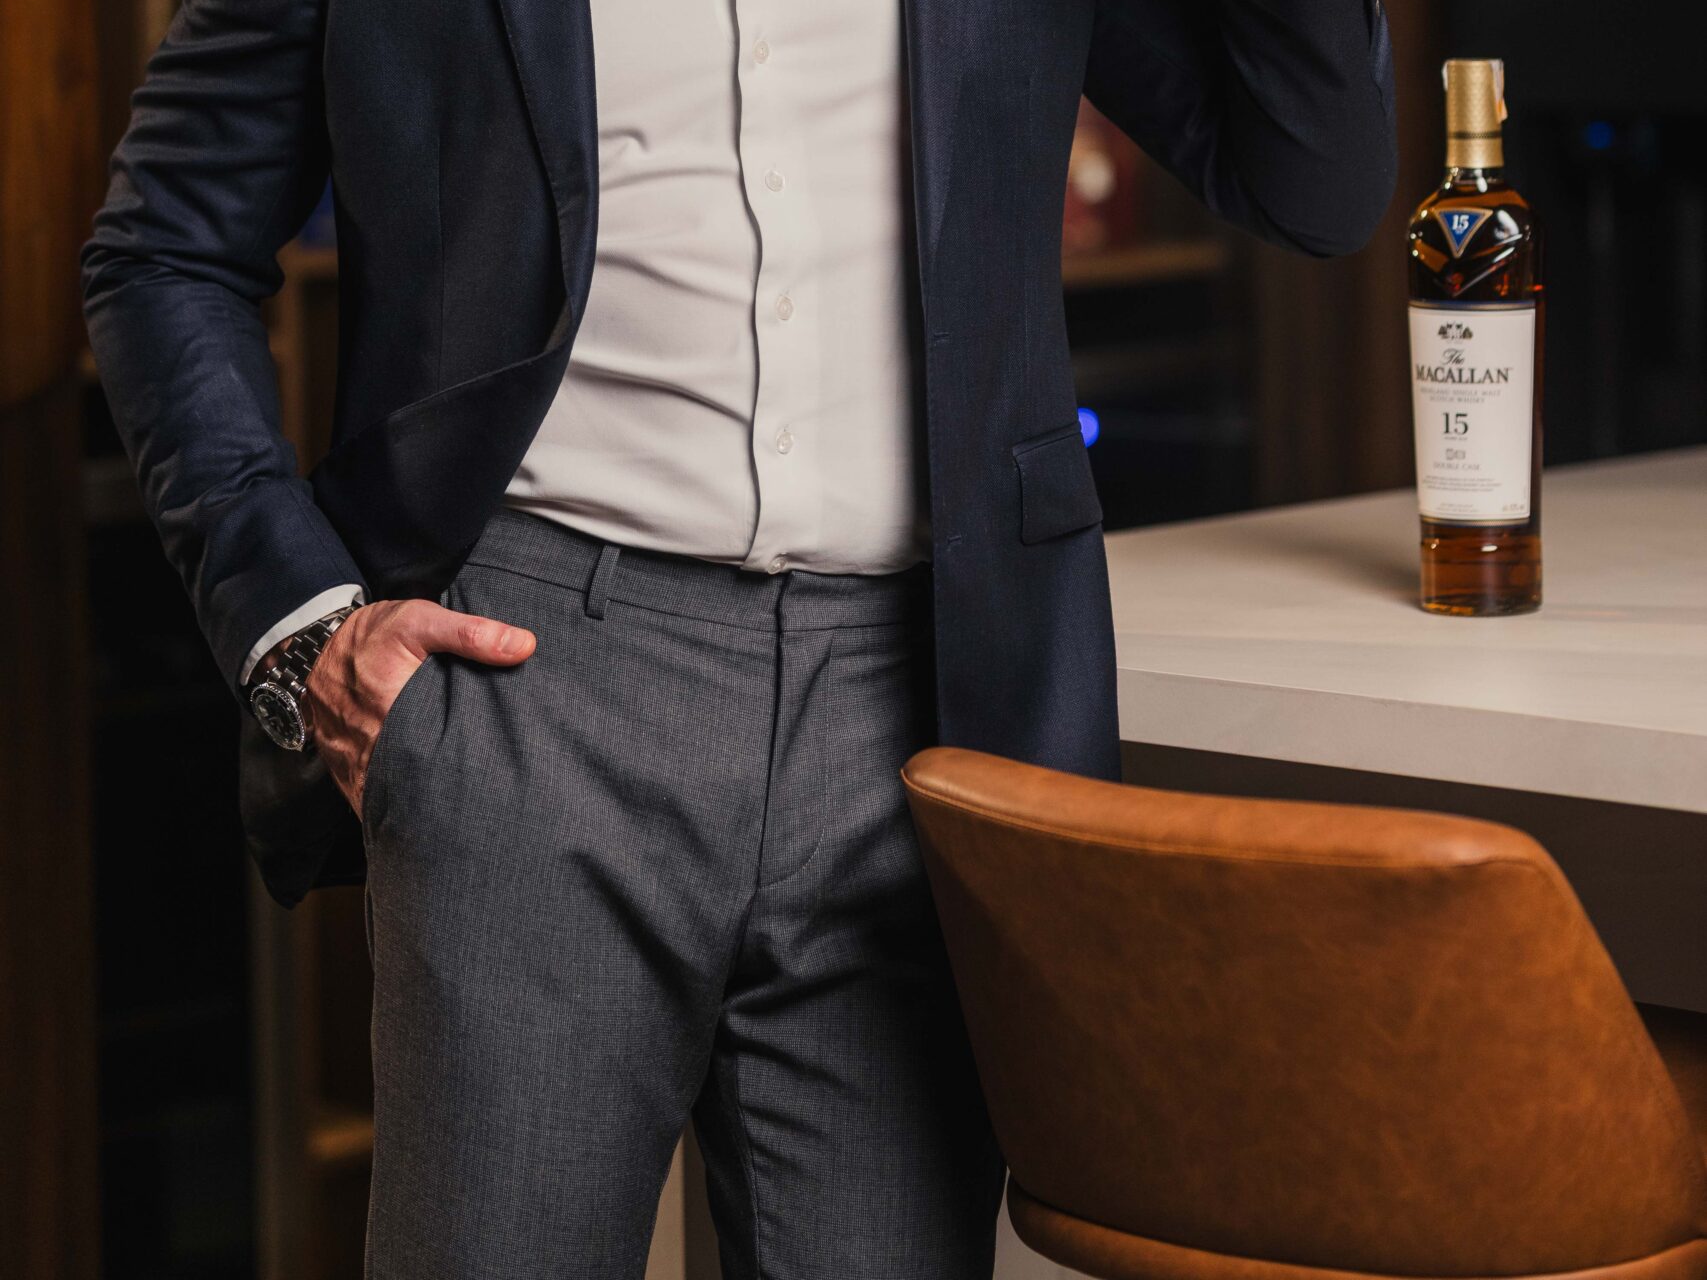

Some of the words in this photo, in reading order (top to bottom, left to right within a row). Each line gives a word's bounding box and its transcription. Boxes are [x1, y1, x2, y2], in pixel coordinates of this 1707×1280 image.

[1452, 214, 1470, 230] 15
[1441, 348, 1465, 365] The
[1415, 364, 1510, 384] MACALLAN
[1442, 412, 1469, 435] 15
